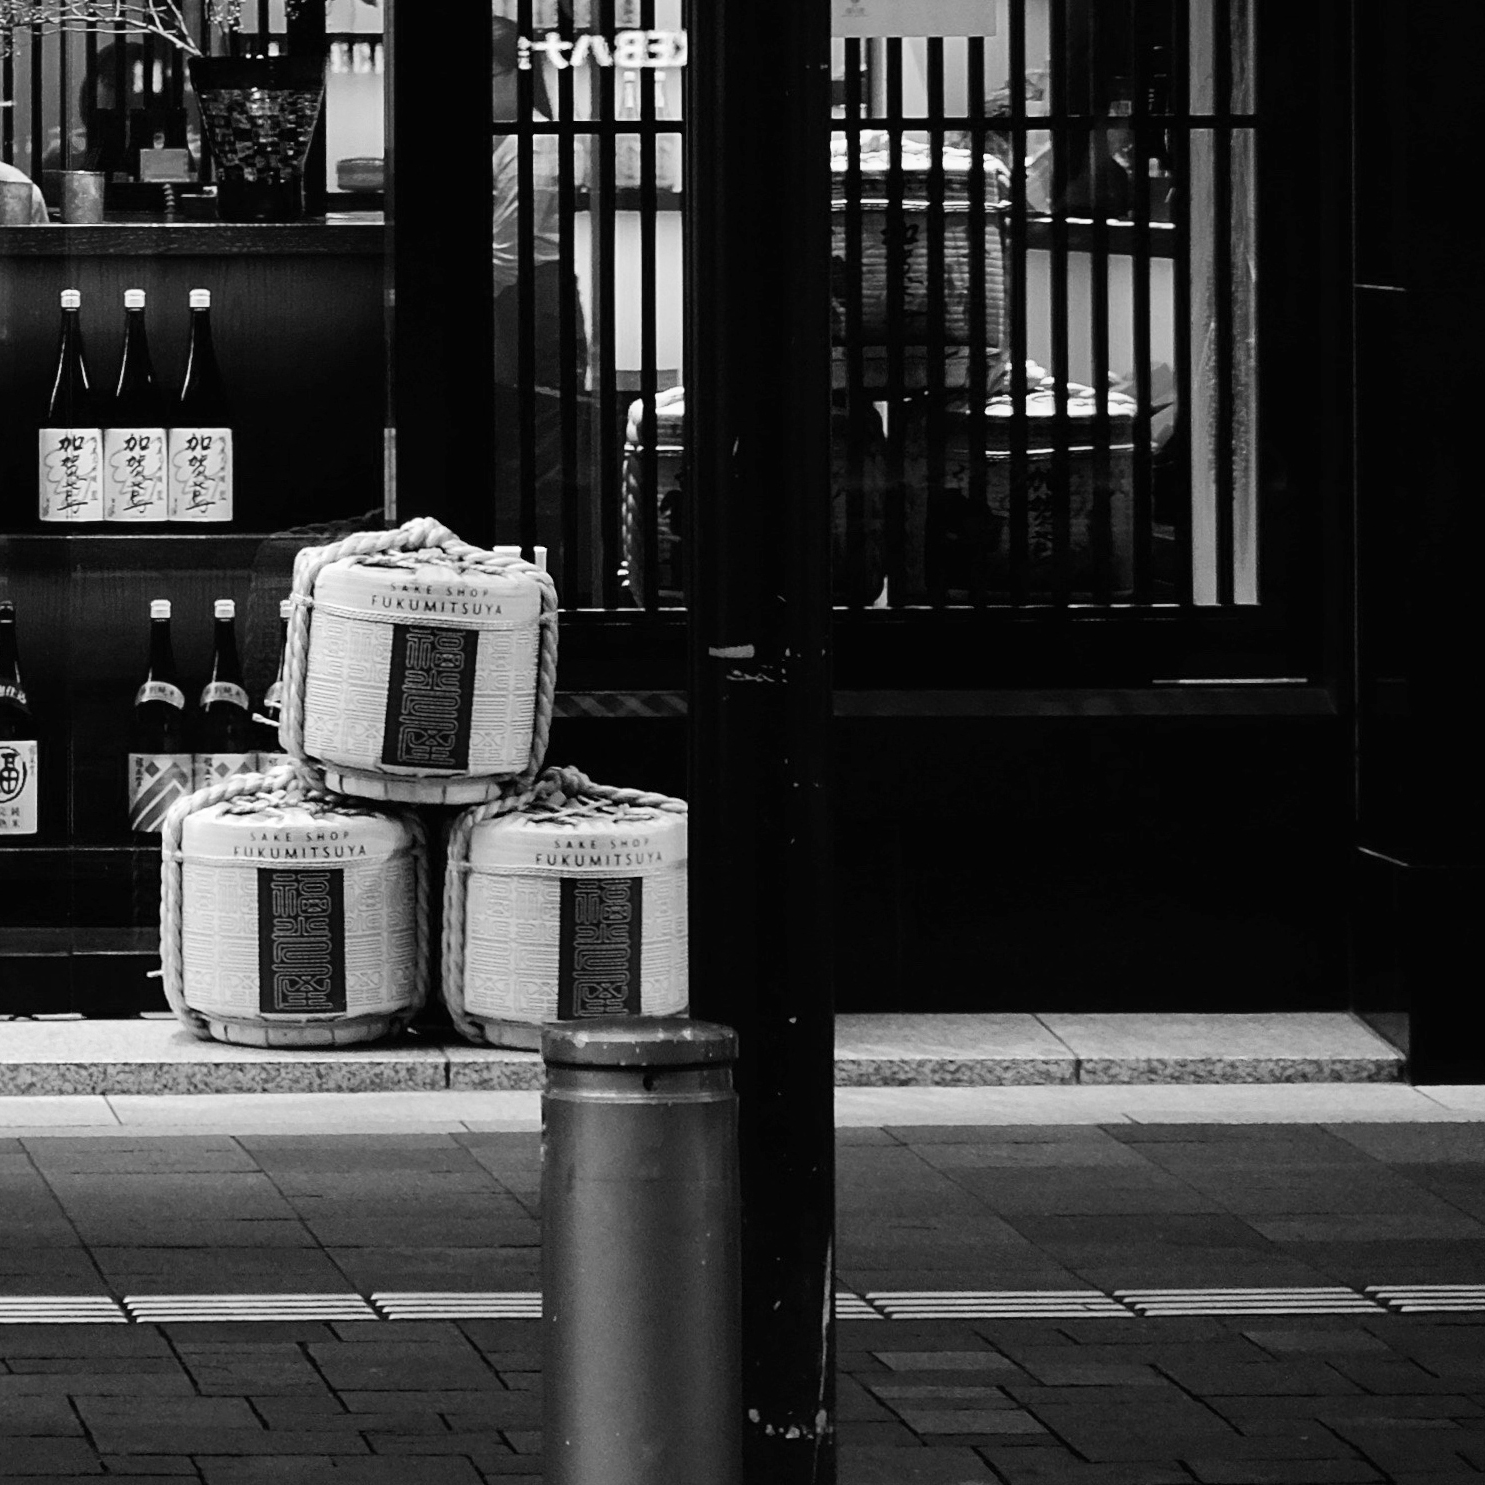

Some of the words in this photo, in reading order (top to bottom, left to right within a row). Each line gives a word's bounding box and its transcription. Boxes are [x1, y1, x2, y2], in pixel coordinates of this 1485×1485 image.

[390, 582, 432, 595] SAKE
[446, 587, 489, 598] SHOP
[371, 595, 503, 615] FUKUMITSUYA
[249, 832, 292, 842] SAKE
[306, 831, 351, 841] SHOP
[554, 840, 597, 850] SAKE
[610, 838, 650, 849] SHOP
[233, 845, 367, 860] FUKUMITSUYA
[535, 851, 663, 866] FUKUMITSUYA
